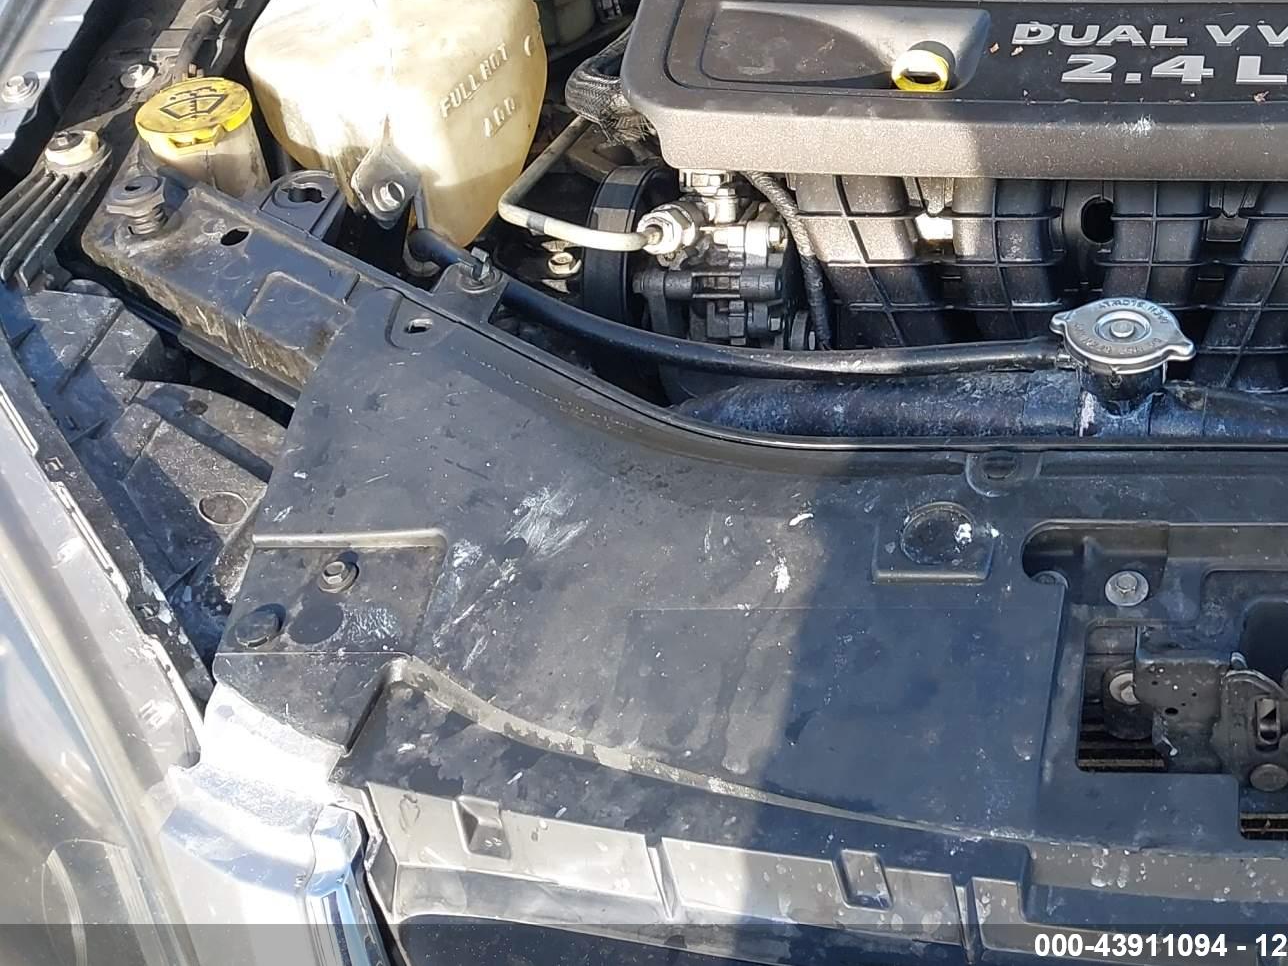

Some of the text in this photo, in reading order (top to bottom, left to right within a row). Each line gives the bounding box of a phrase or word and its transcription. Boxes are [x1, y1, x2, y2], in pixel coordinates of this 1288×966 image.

[1011, 23, 1188, 47] DUAL
[440, 42, 508, 119] FULL HOT
[1060, 54, 1288, 84] 2.4 L
